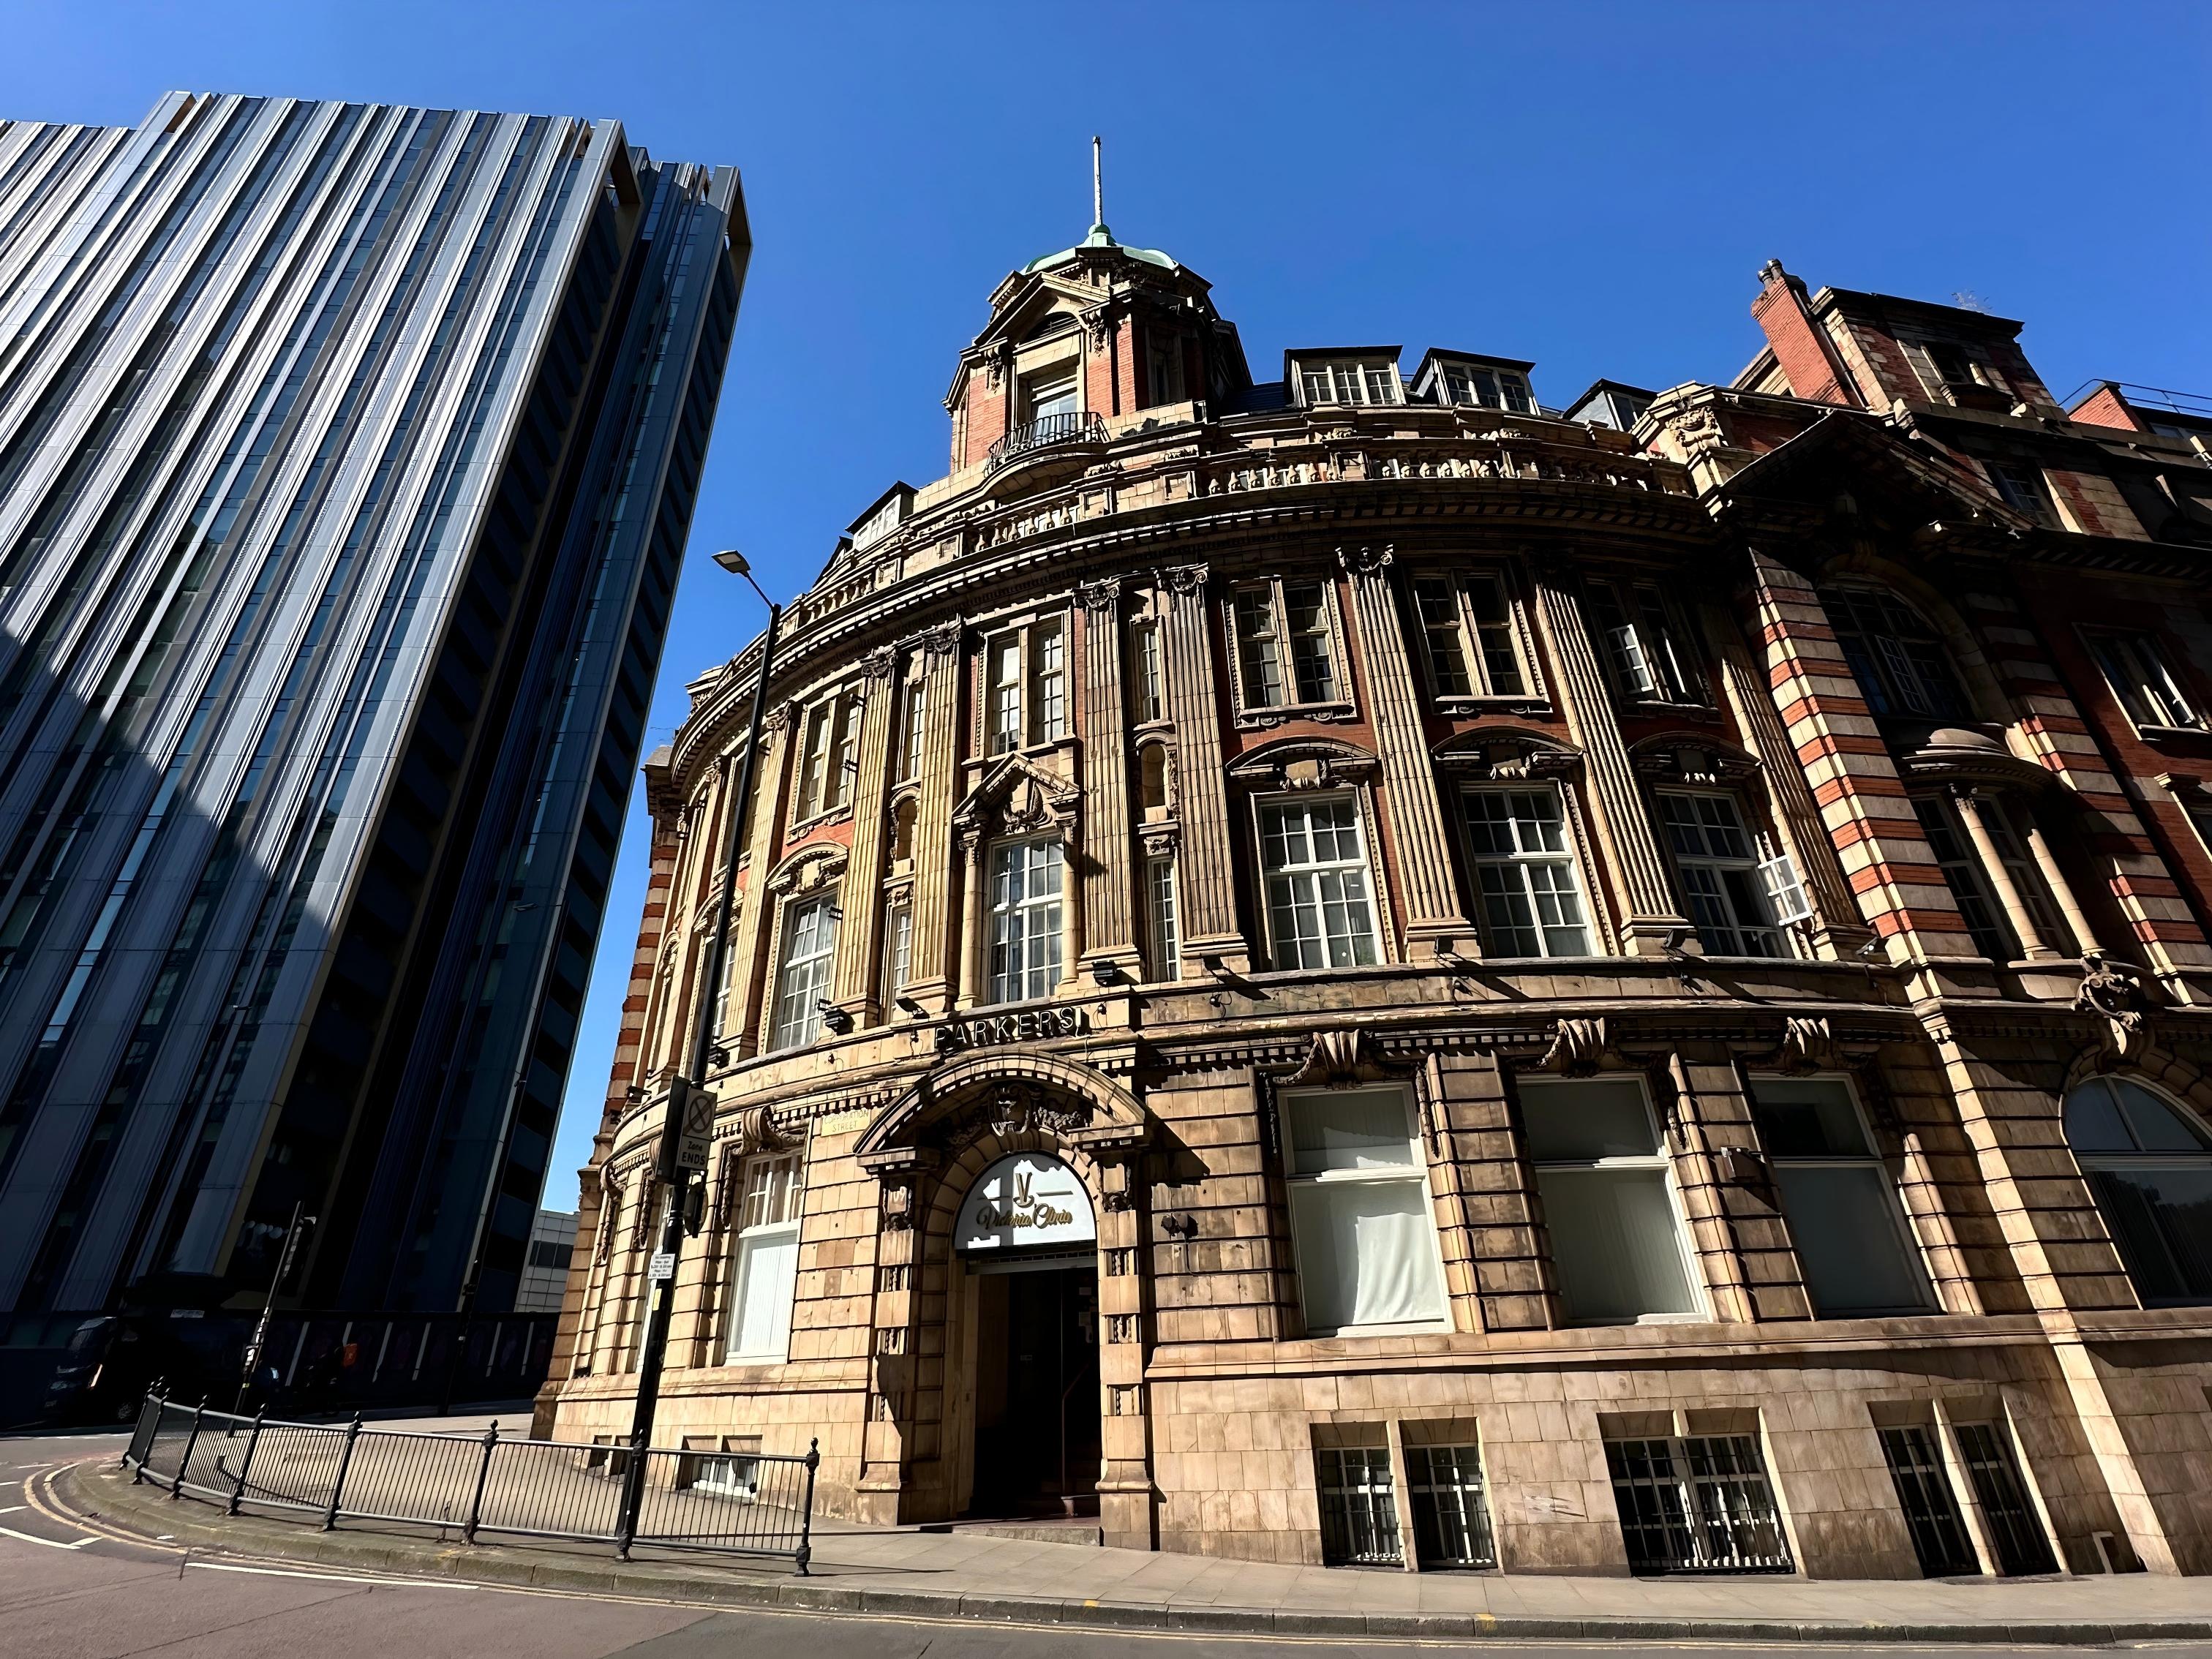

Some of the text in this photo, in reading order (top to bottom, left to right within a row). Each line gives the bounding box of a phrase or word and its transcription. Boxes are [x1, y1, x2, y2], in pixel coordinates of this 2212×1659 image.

[935, 1006, 1075, 1048] PARKERS
[832, 1120, 858, 1132] STREET
[686, 1140, 702, 1151] Zone
[682, 1151, 706, 1165] ENDS
[1032, 1203, 1073, 1229] Clinic
